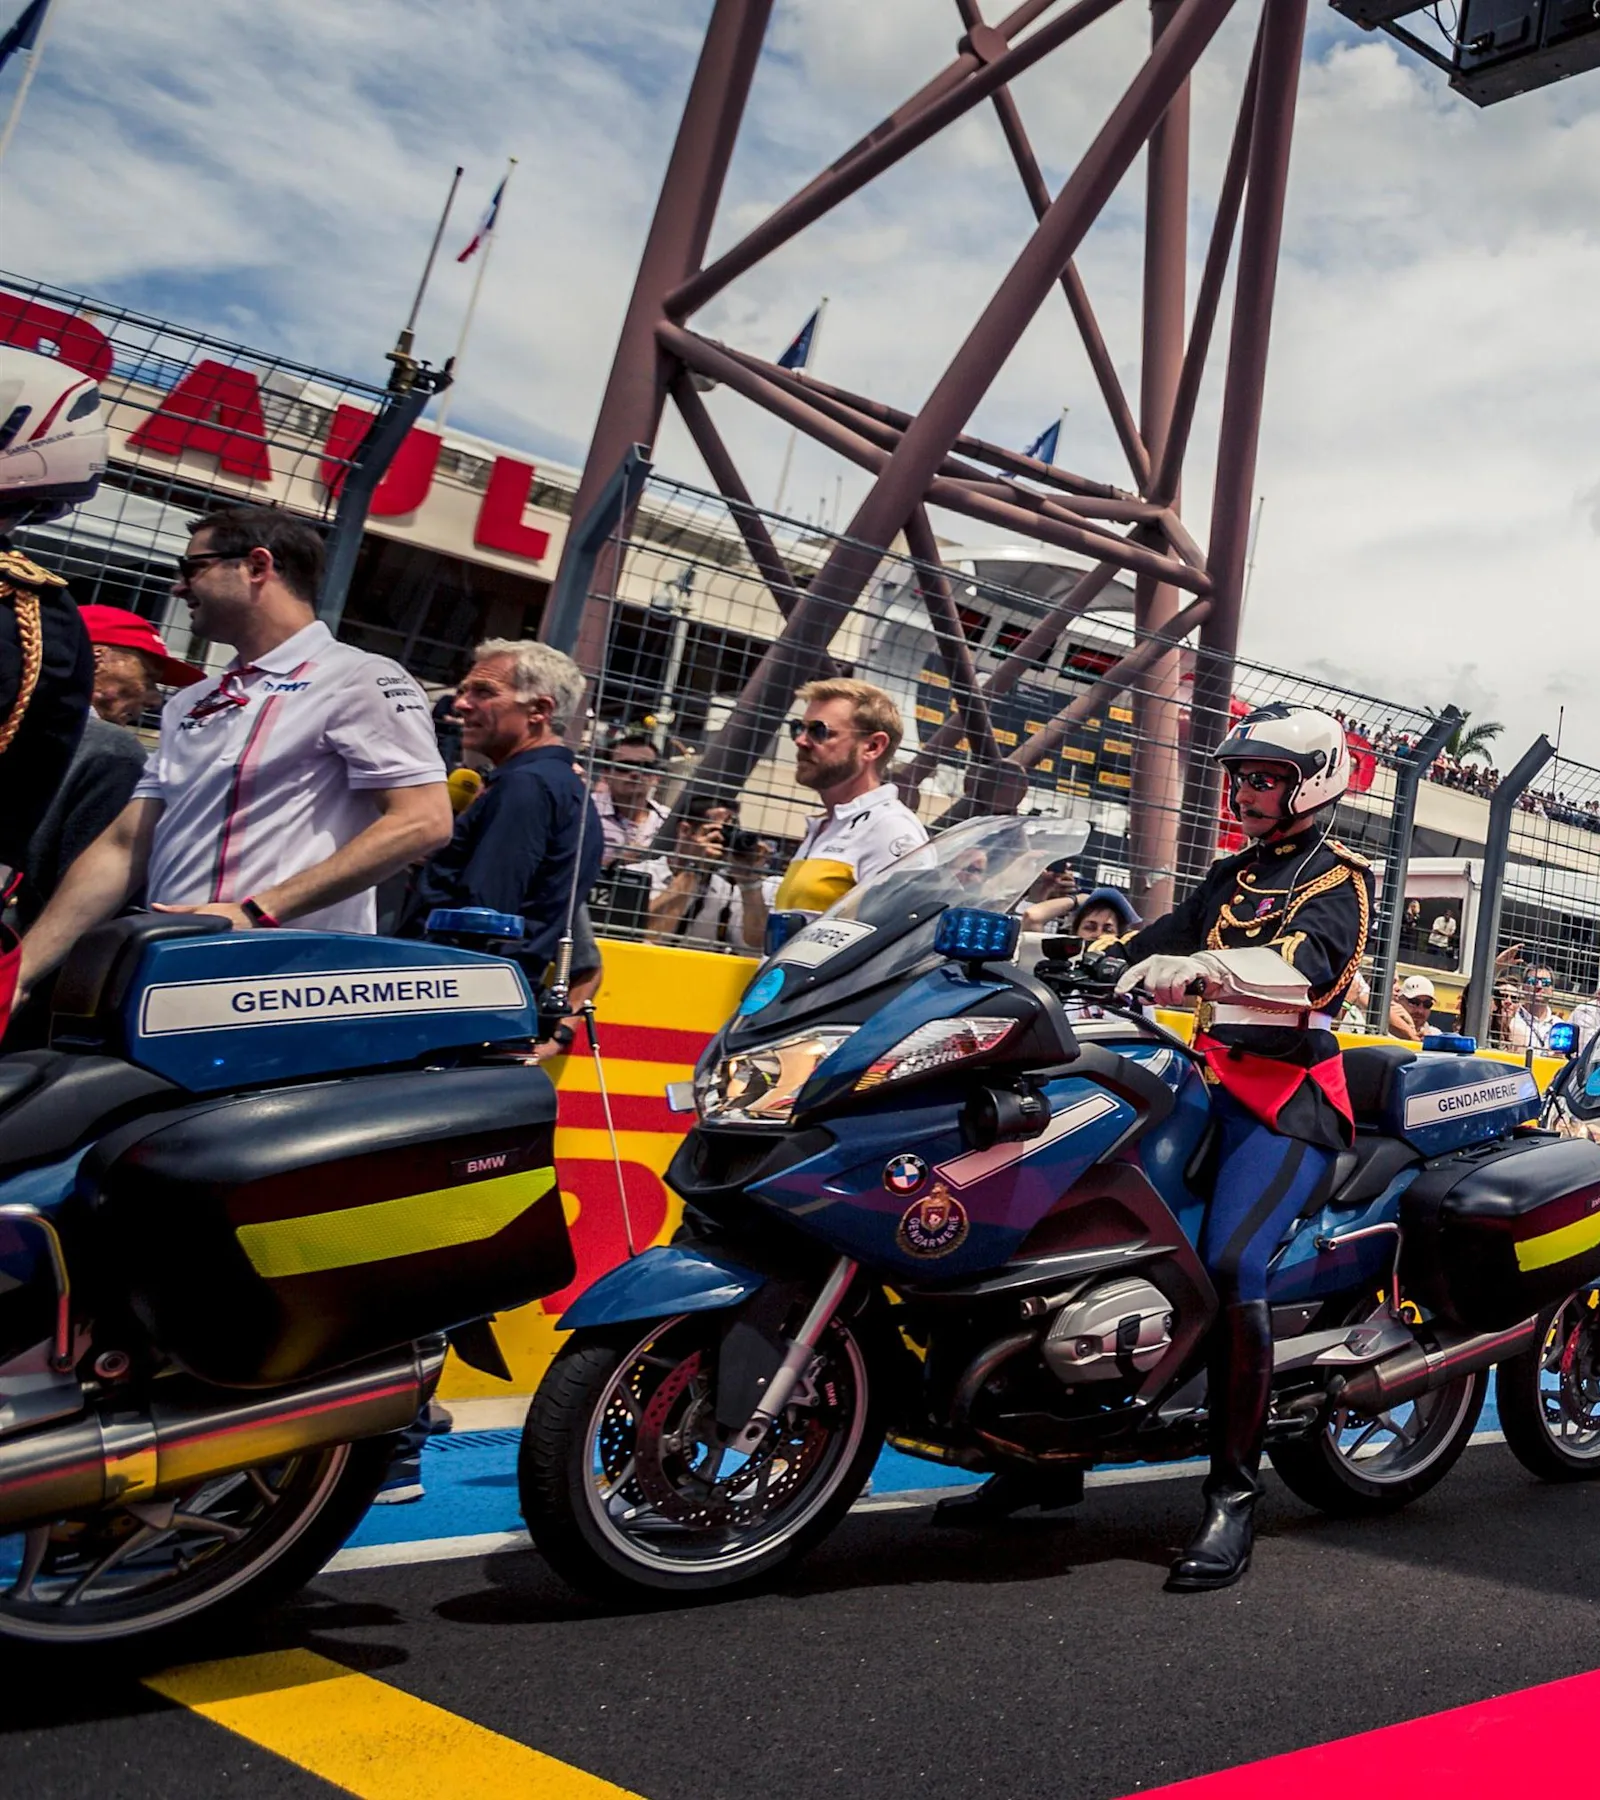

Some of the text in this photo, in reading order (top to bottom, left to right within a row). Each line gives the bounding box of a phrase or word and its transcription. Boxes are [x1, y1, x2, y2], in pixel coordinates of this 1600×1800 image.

[589, 887, 609, 906] 12
[232, 979, 460, 1013] GENDARMERIE
[1438, 1083, 1517, 1112] GENDARMERIE
[467, 1154, 507, 1173] BMW
[907, 1215, 960, 1248] GENDARMERIE
